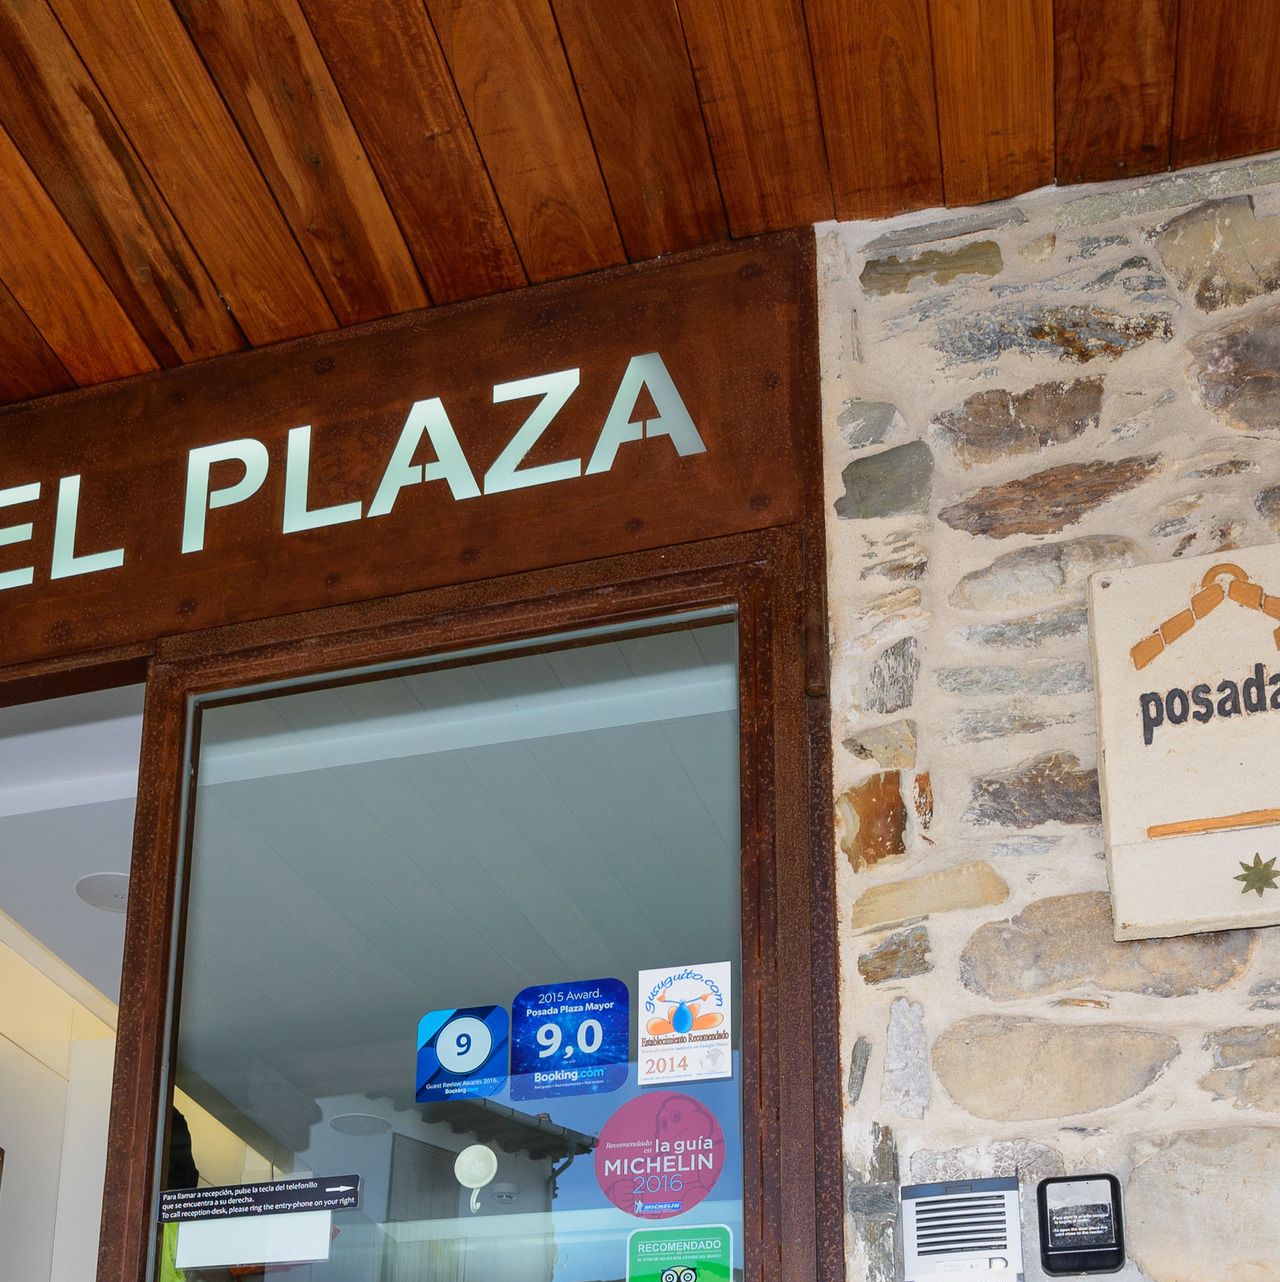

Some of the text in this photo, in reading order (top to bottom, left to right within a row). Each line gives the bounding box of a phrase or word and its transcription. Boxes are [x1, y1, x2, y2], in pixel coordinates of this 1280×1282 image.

[181, 352, 707, 554] PLAZA
[538, 988, 602, 1004] 2015 Award.
[526, 1001, 615, 1017] Posada Plaza Mayor
[455, 1033, 472, 1056] 9
[535, 1019, 603, 1059] 9,0
[645, 1055, 688, 1074] 2014
[534, 1067, 605, 1082] Booking.com
[605, 1140, 652, 1149] Recomendado
[655, 1136, 713, 1154] la guía
[604, 1153, 713, 1176] MICHELIN
[234, 1187, 251, 1196] pulse
[286, 1181, 318, 1190] telefonillo
[632, 1174, 683, 1194] 2016
[182, 1200, 213, 1208] encuentra
[227, 1196, 254, 1204] derecha.
[228, 1206, 249, 1214] please
[249, 1204, 262, 1212] ring
[274, 1200, 313, 1210] entry-phone
[323, 1198, 338, 1207] your
[339, 1196, 355, 1206] right
[644, 1202, 680, 1210] MICHELIN
[637, 1240, 722, 1253] RECOMENDADO
